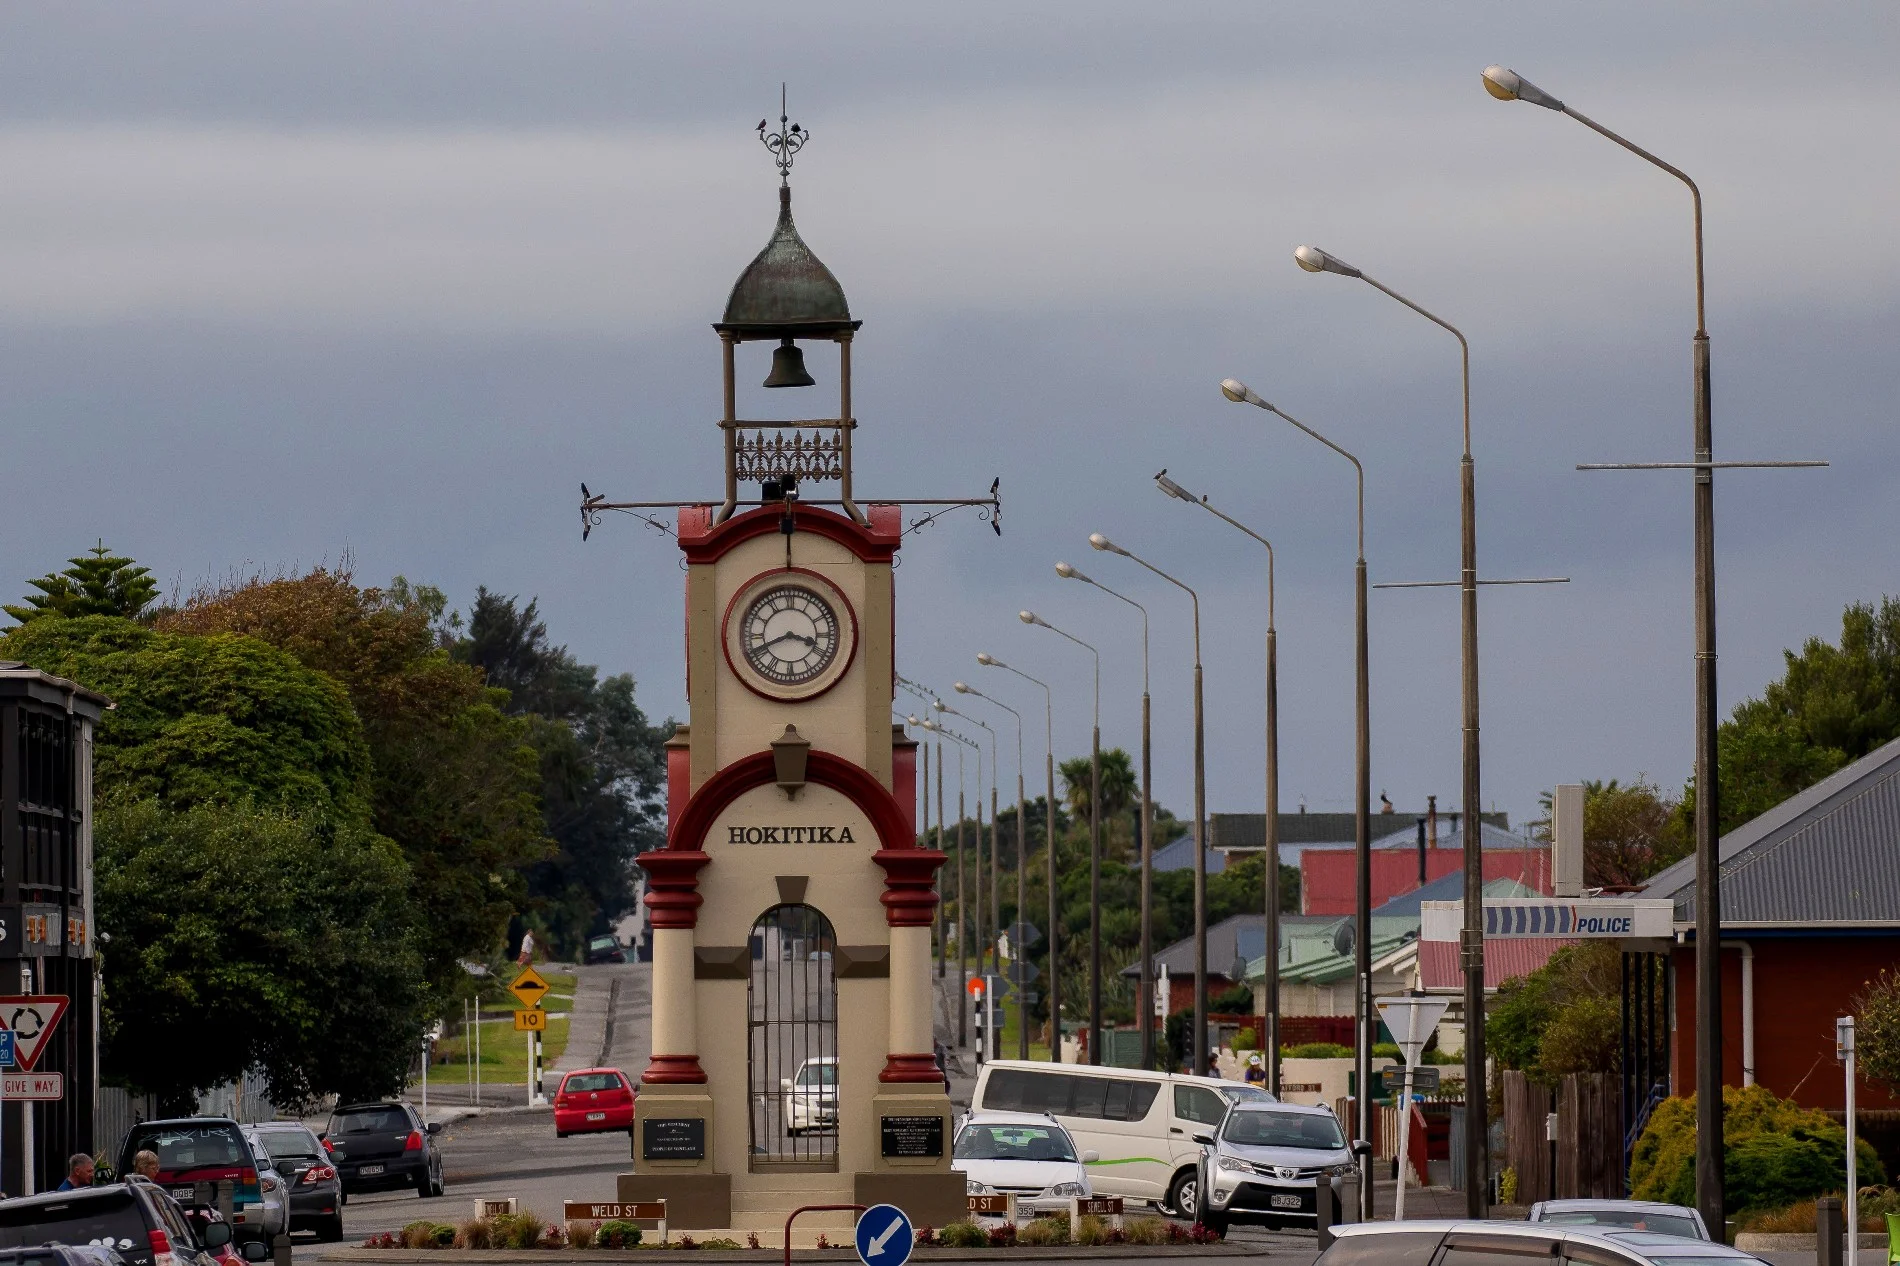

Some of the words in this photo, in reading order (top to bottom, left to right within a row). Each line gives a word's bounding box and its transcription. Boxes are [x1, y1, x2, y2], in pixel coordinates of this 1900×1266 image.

[728, 826, 856, 844] HOKITIKA
[1577, 917, 1631, 934] POLICE
[522, 1014, 538, 1026] 10
[0, 1033, 8, 1046] P
[5, 1080, 27, 1093] GIVE
[34, 1080, 54, 1093] WAY
[980, 1197, 992, 1209] ST
[1087, 1202, 1106, 1213] SEWELL
[1107, 1201, 1114, 1212] ST
[1272, 1196, 1300, 1206] HBJ322
[591, 1205, 621, 1217] WELD
[625, 1205, 638, 1217] ST
[1018, 1207, 1034, 1216] 353
